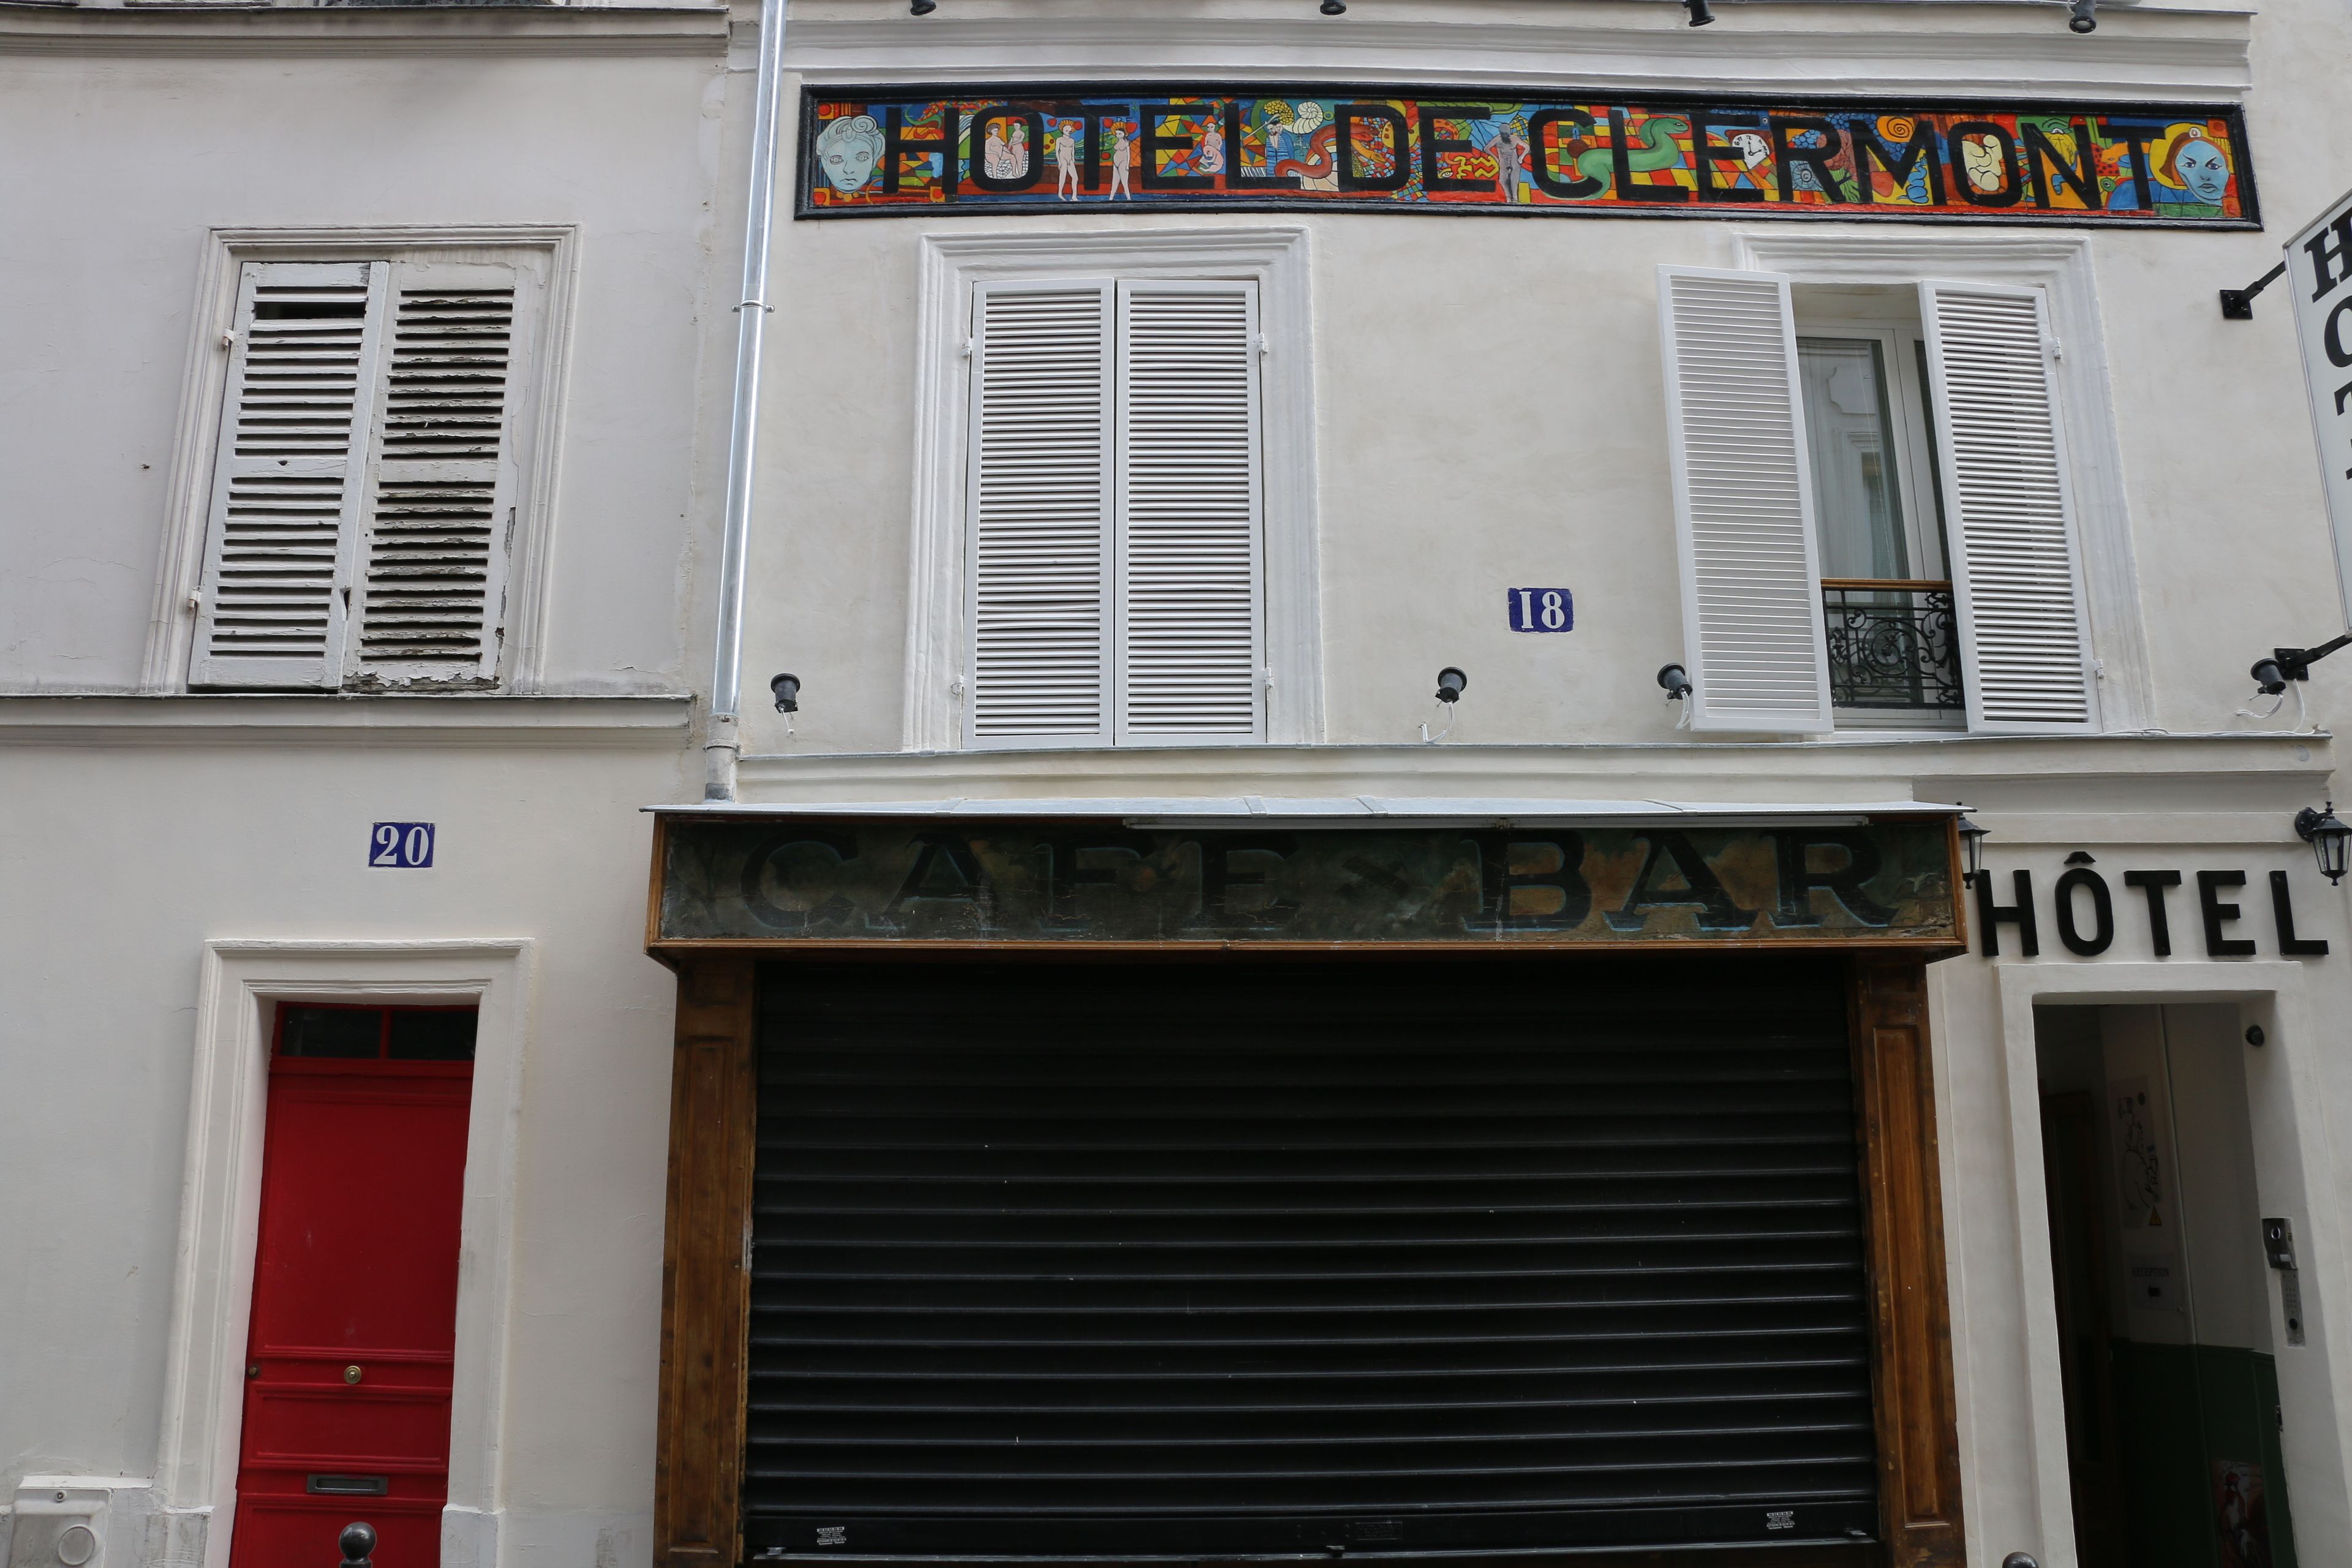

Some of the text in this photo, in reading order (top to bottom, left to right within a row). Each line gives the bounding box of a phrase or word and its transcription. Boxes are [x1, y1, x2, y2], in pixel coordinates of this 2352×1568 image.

[882, 103, 2166, 211] HOTEL DE CLERMONT
[1519, 591, 1565, 629] 18
[373, 825, 429, 865] 20
[1460, 829, 1903, 933] BAR
[1975, 851, 2329, 957] HÔTEL
